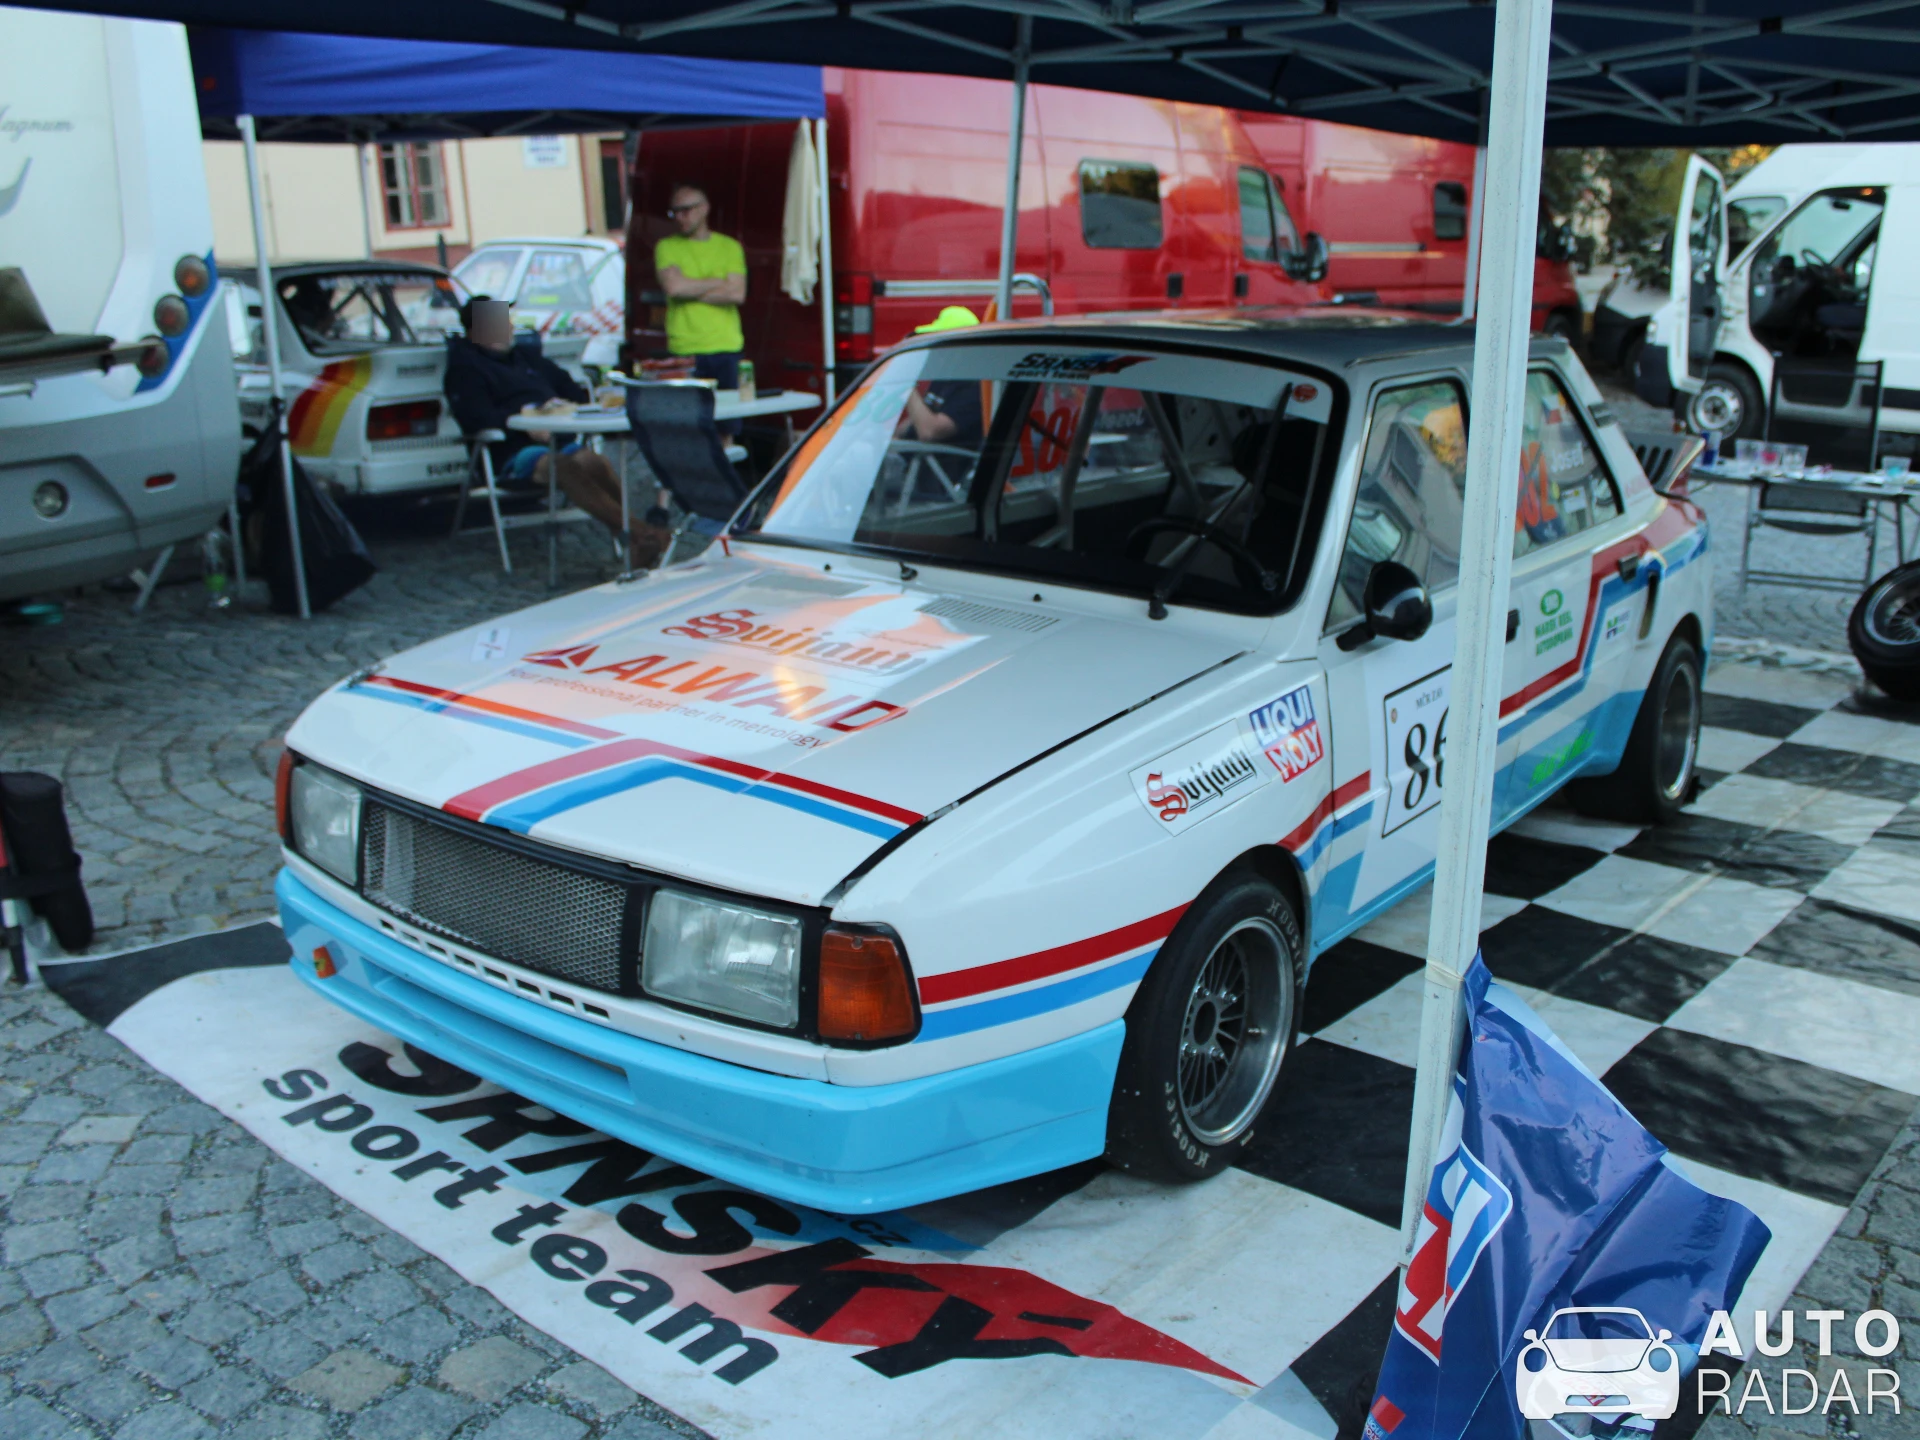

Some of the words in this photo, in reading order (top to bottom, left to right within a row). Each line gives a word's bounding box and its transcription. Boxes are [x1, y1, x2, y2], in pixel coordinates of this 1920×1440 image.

[582, 655, 908, 732] ALWAID
[1251, 687, 1313, 744] LIQUI
[705, 712, 726, 723] in
[725, 717, 829, 749] metrology
[1268, 724, 1321, 779] MOLY
[1146, 748, 1257, 822] Svijany
[262, 1068, 510, 1211] sport
[491, 1201, 779, 1386] team
